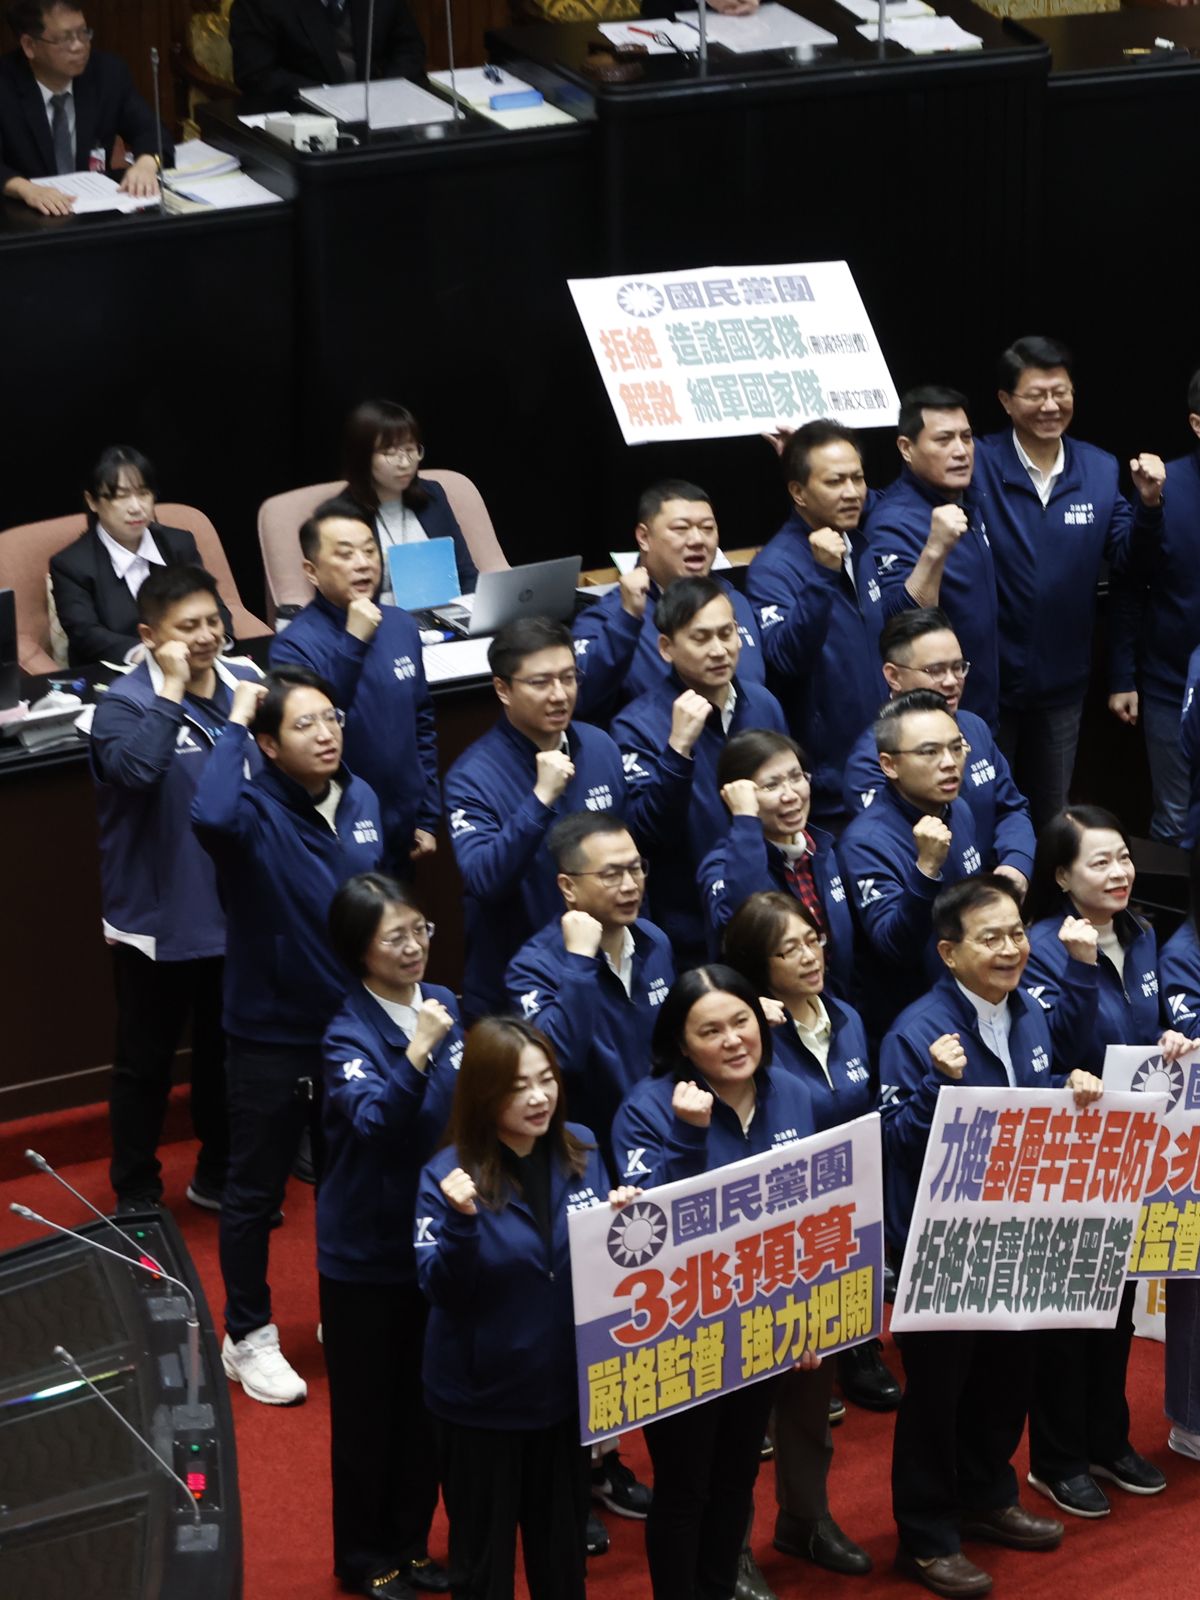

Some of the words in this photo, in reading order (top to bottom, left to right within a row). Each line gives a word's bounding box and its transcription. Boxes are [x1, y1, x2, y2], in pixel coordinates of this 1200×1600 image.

[664, 275, 815, 310] 國民黨團
[600, 326, 662, 372] 拒絕
[665, 314, 808, 367] 造謠國家隊
[619, 380, 682, 427] 解散
[686, 369, 828, 423] 網軍國家隊
[671, 1139, 853, 1246] 國民黨團
[930, 1106, 1158, 1203] 力挺基層辛苦民防
[610, 1202, 859, 1345] 3兆預算
[587, 1321, 725, 1434] 嚴格監督
[740, 1266, 873, 1379] 強力把關
